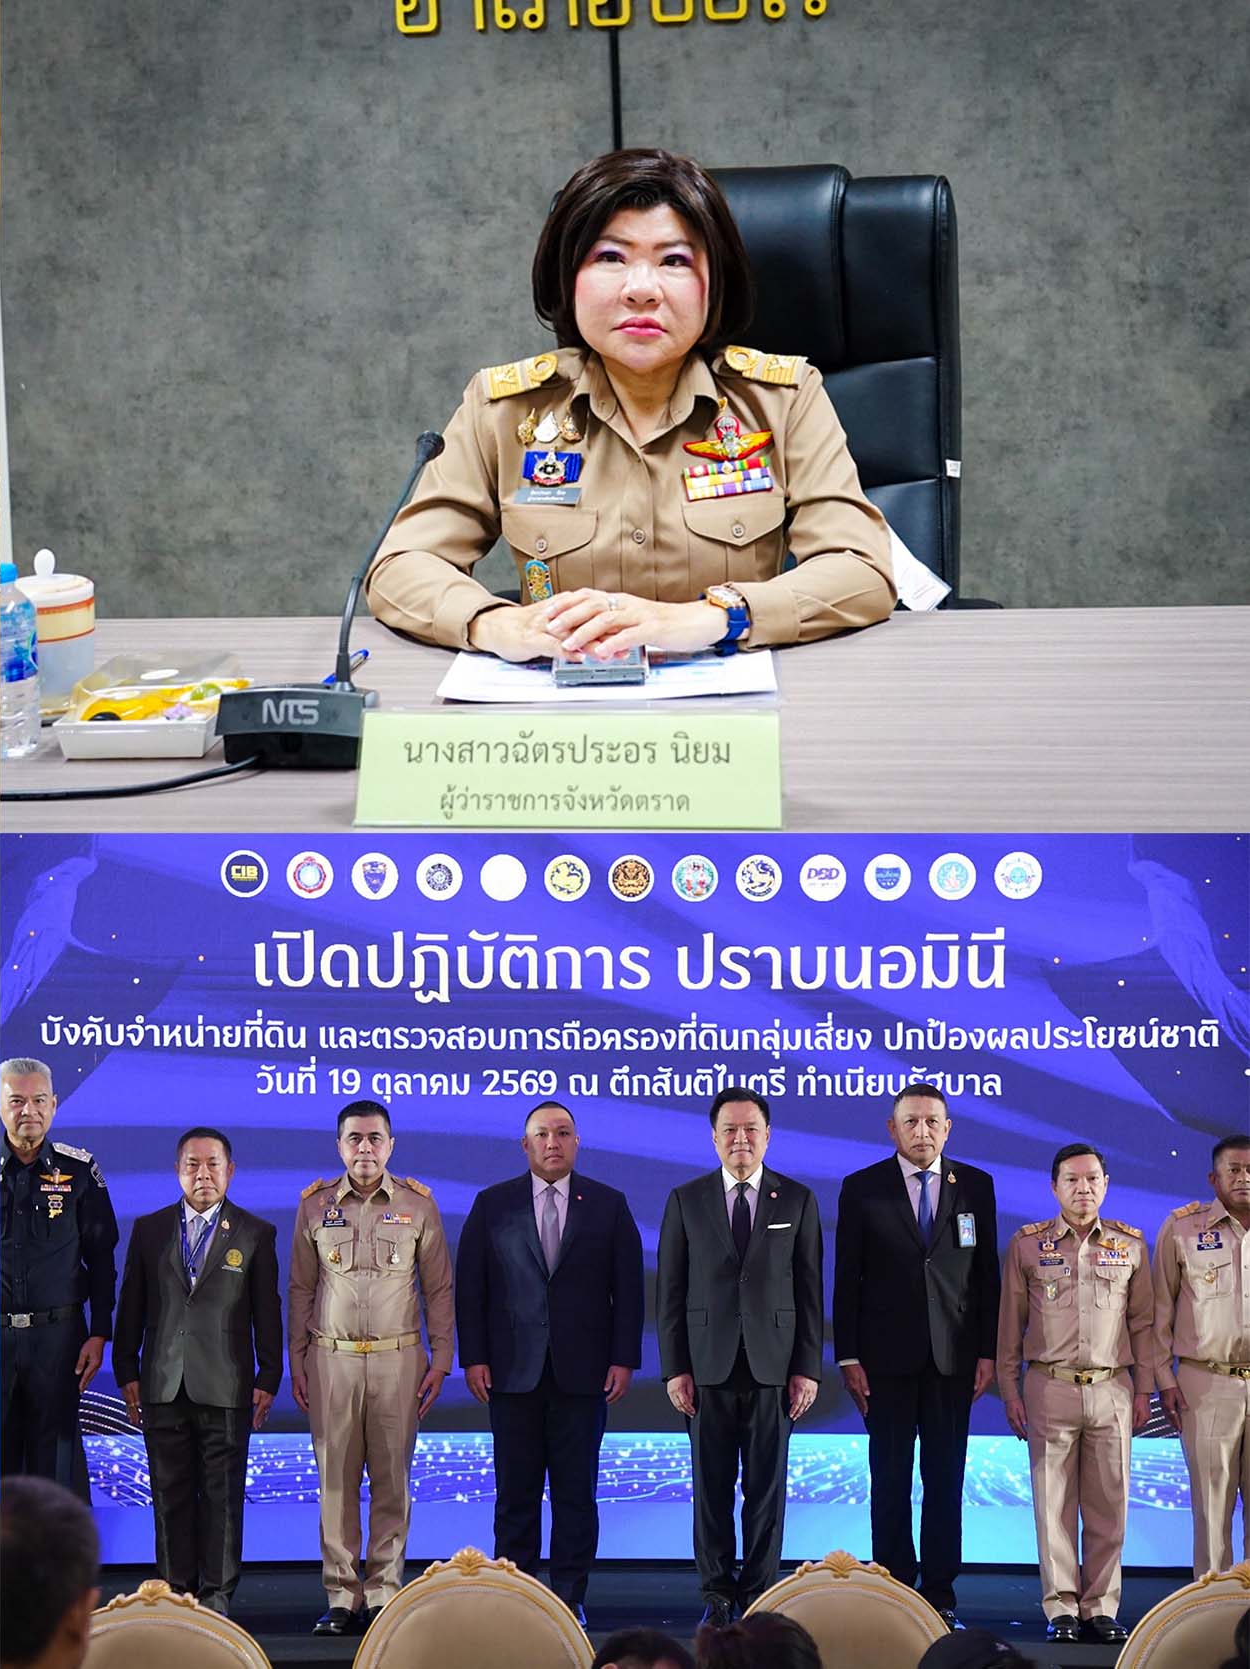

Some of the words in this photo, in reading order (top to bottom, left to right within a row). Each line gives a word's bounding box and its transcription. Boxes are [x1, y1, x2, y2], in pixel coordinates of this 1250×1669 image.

[404, 730, 657, 765] นางสาวฉัตรประอร
[670, 732, 731, 764] นิยม
[440, 784, 690, 820] ผู้ว่าราชการจังหวัดตราด
[230, 864, 259, 878] CIB
[254, 929, 651, 1004] เปิดปฏิบัติการ
[676, 926, 1006, 990] ปราบนอมินี
[40, 1008, 307, 1049] บังคับจำหน่ายที่ดิน
[319, 1012, 873, 1059] และตรวจสอบการถือครองที่ดินกลุ่มเสี่ยง
[883, 1016, 1219, 1051] ปกป้องผลประโยชน์ชาติ
[256, 1055, 317, 1095] วันที่
[328, 1068, 361, 1095] 19
[371, 1070, 471, 1104] ตุลาคม
[481, 1069, 558, 1096] 2569
[568, 1074, 599, 1096] ณ
